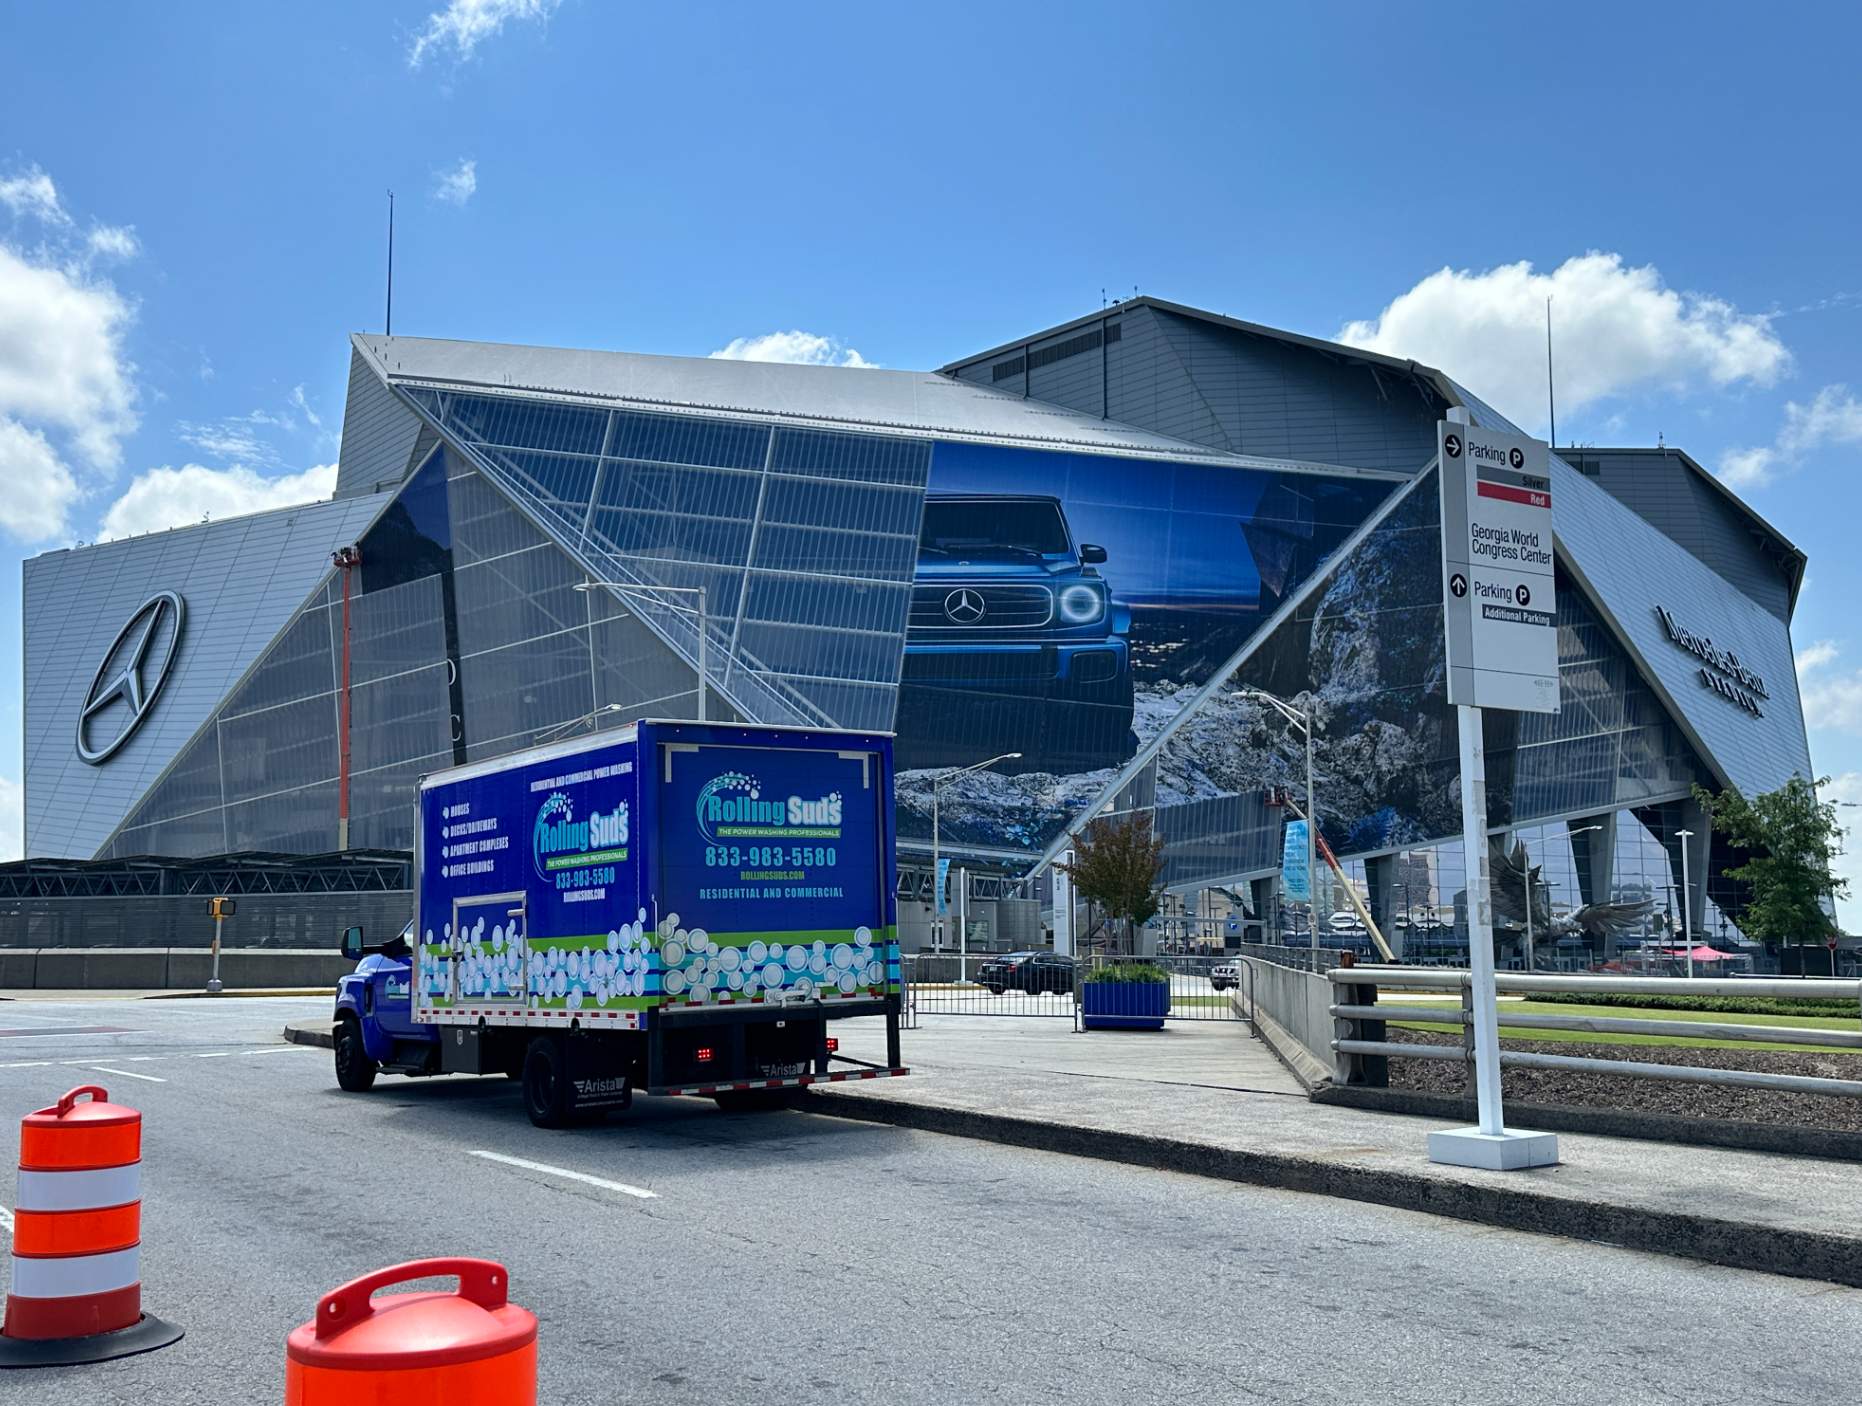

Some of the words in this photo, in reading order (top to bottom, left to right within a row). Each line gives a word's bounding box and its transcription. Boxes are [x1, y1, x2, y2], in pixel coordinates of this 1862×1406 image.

[1468, 441, 1506, 465] Parking
[1522, 474, 1545, 490] Silver
[1530, 493, 1545, 506] Red
[1471, 522, 1510, 544] Georgia
[1511, 528, 1539, 548] World
[1471, 538, 1518, 561] Congress
[1520, 545, 1552, 565] Center
[1474, 580, 1513, 603] Parking
[1484, 607, 1522, 623] Additional
[1523, 611, 1550, 627] Parking
[707, 796, 786, 826] Rolling
[787, 794, 842, 825] Suds
[540, 818, 589, 854] Rolling
[589, 806, 629, 849] Suds
[719, 828, 732, 836] THE
[732, 828, 757, 836] POWER
[757, 828, 788, 836] WASHING
[789, 829, 840, 837] PROFESSIONALS
[450, 841, 478, 858] APARTMENT
[705, 846, 836, 867] 833-983-5580
[556, 866, 615, 890] 833-983-5580
[700, 888, 760, 900] RESIDENTIAL
[763, 887, 782, 899] AND
[784, 886, 844, 899] COMMERCIAL
[584, 1078, 616, 1093] Arista
